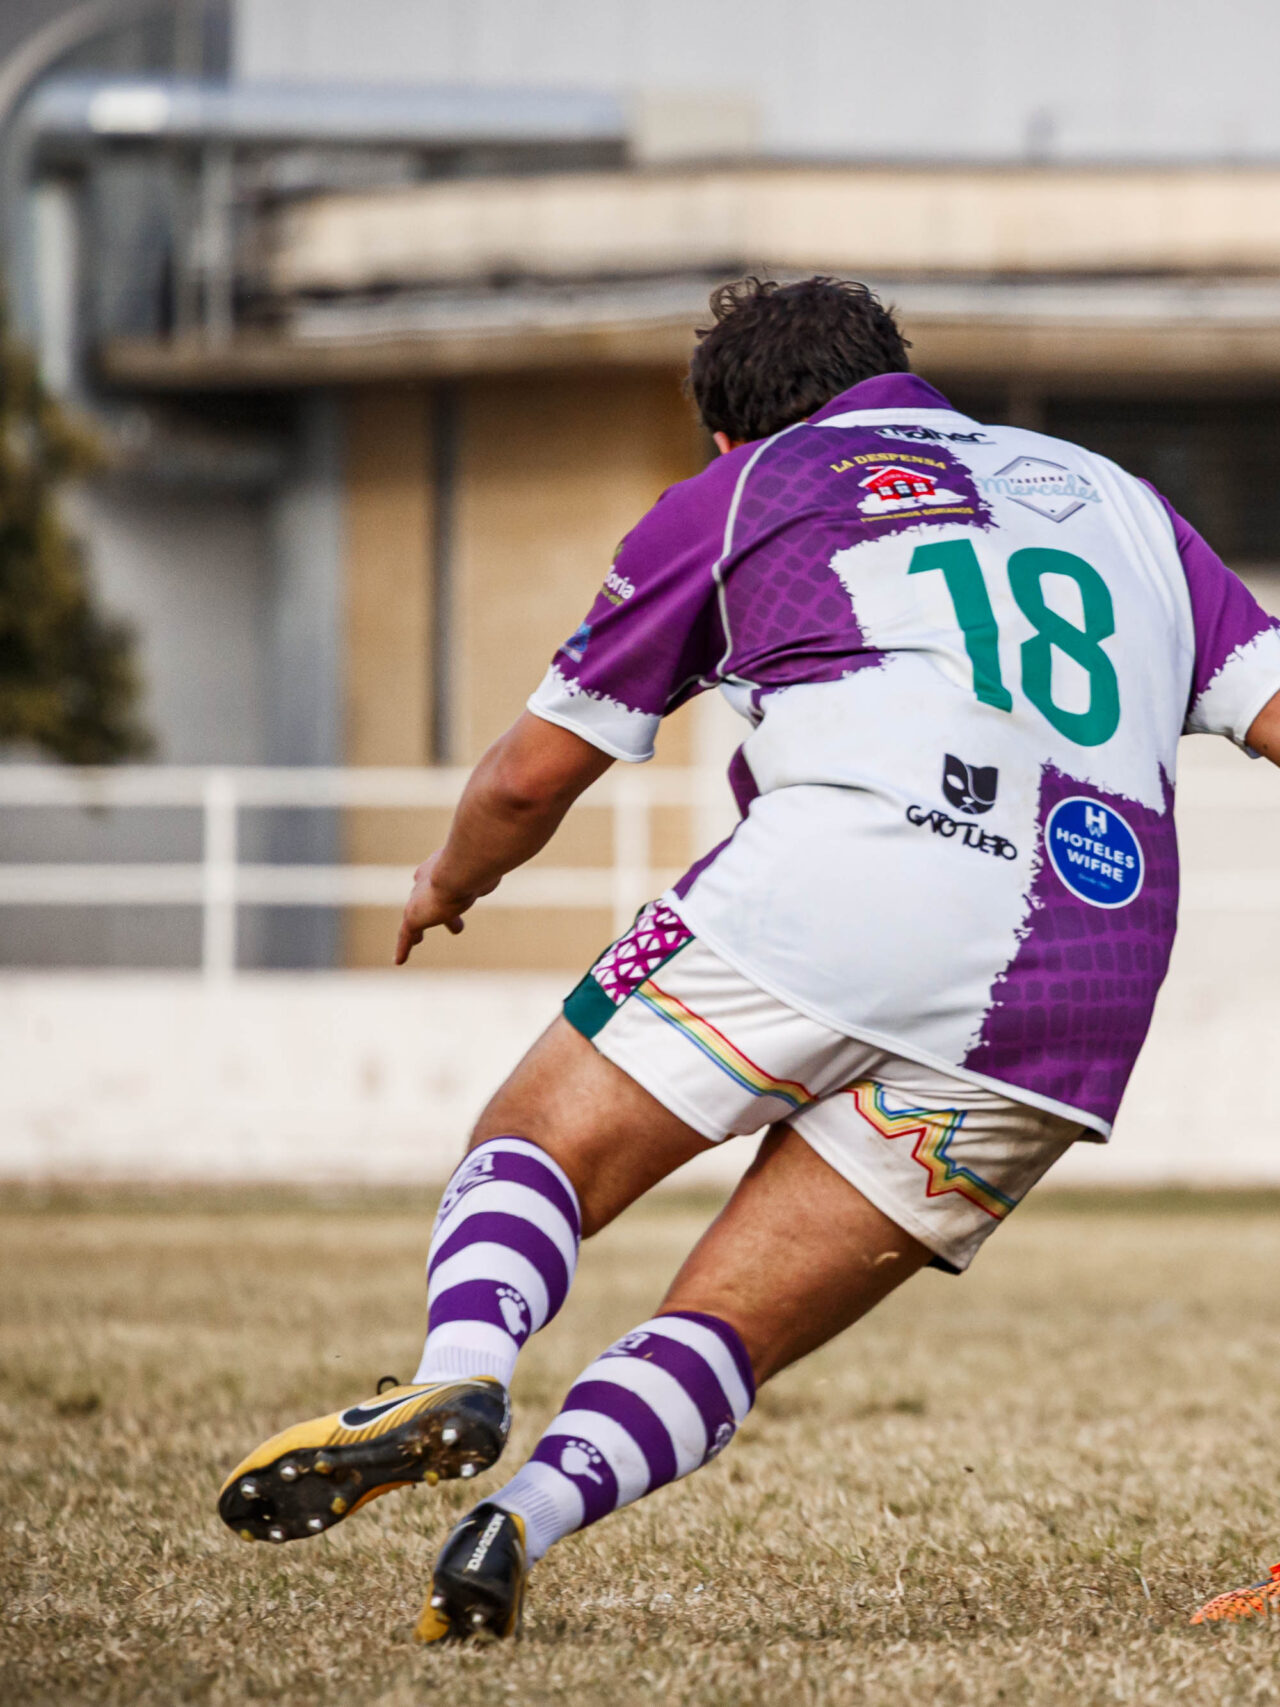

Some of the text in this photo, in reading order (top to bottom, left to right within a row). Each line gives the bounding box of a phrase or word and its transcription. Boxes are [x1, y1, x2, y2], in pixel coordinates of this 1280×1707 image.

[830, 453, 947, 473] LA DESPENSA
[907, 538, 1120, 747] 18
[1056, 827, 1135, 869] HOTELES
[1066, 849, 1124, 883] WIFRE
